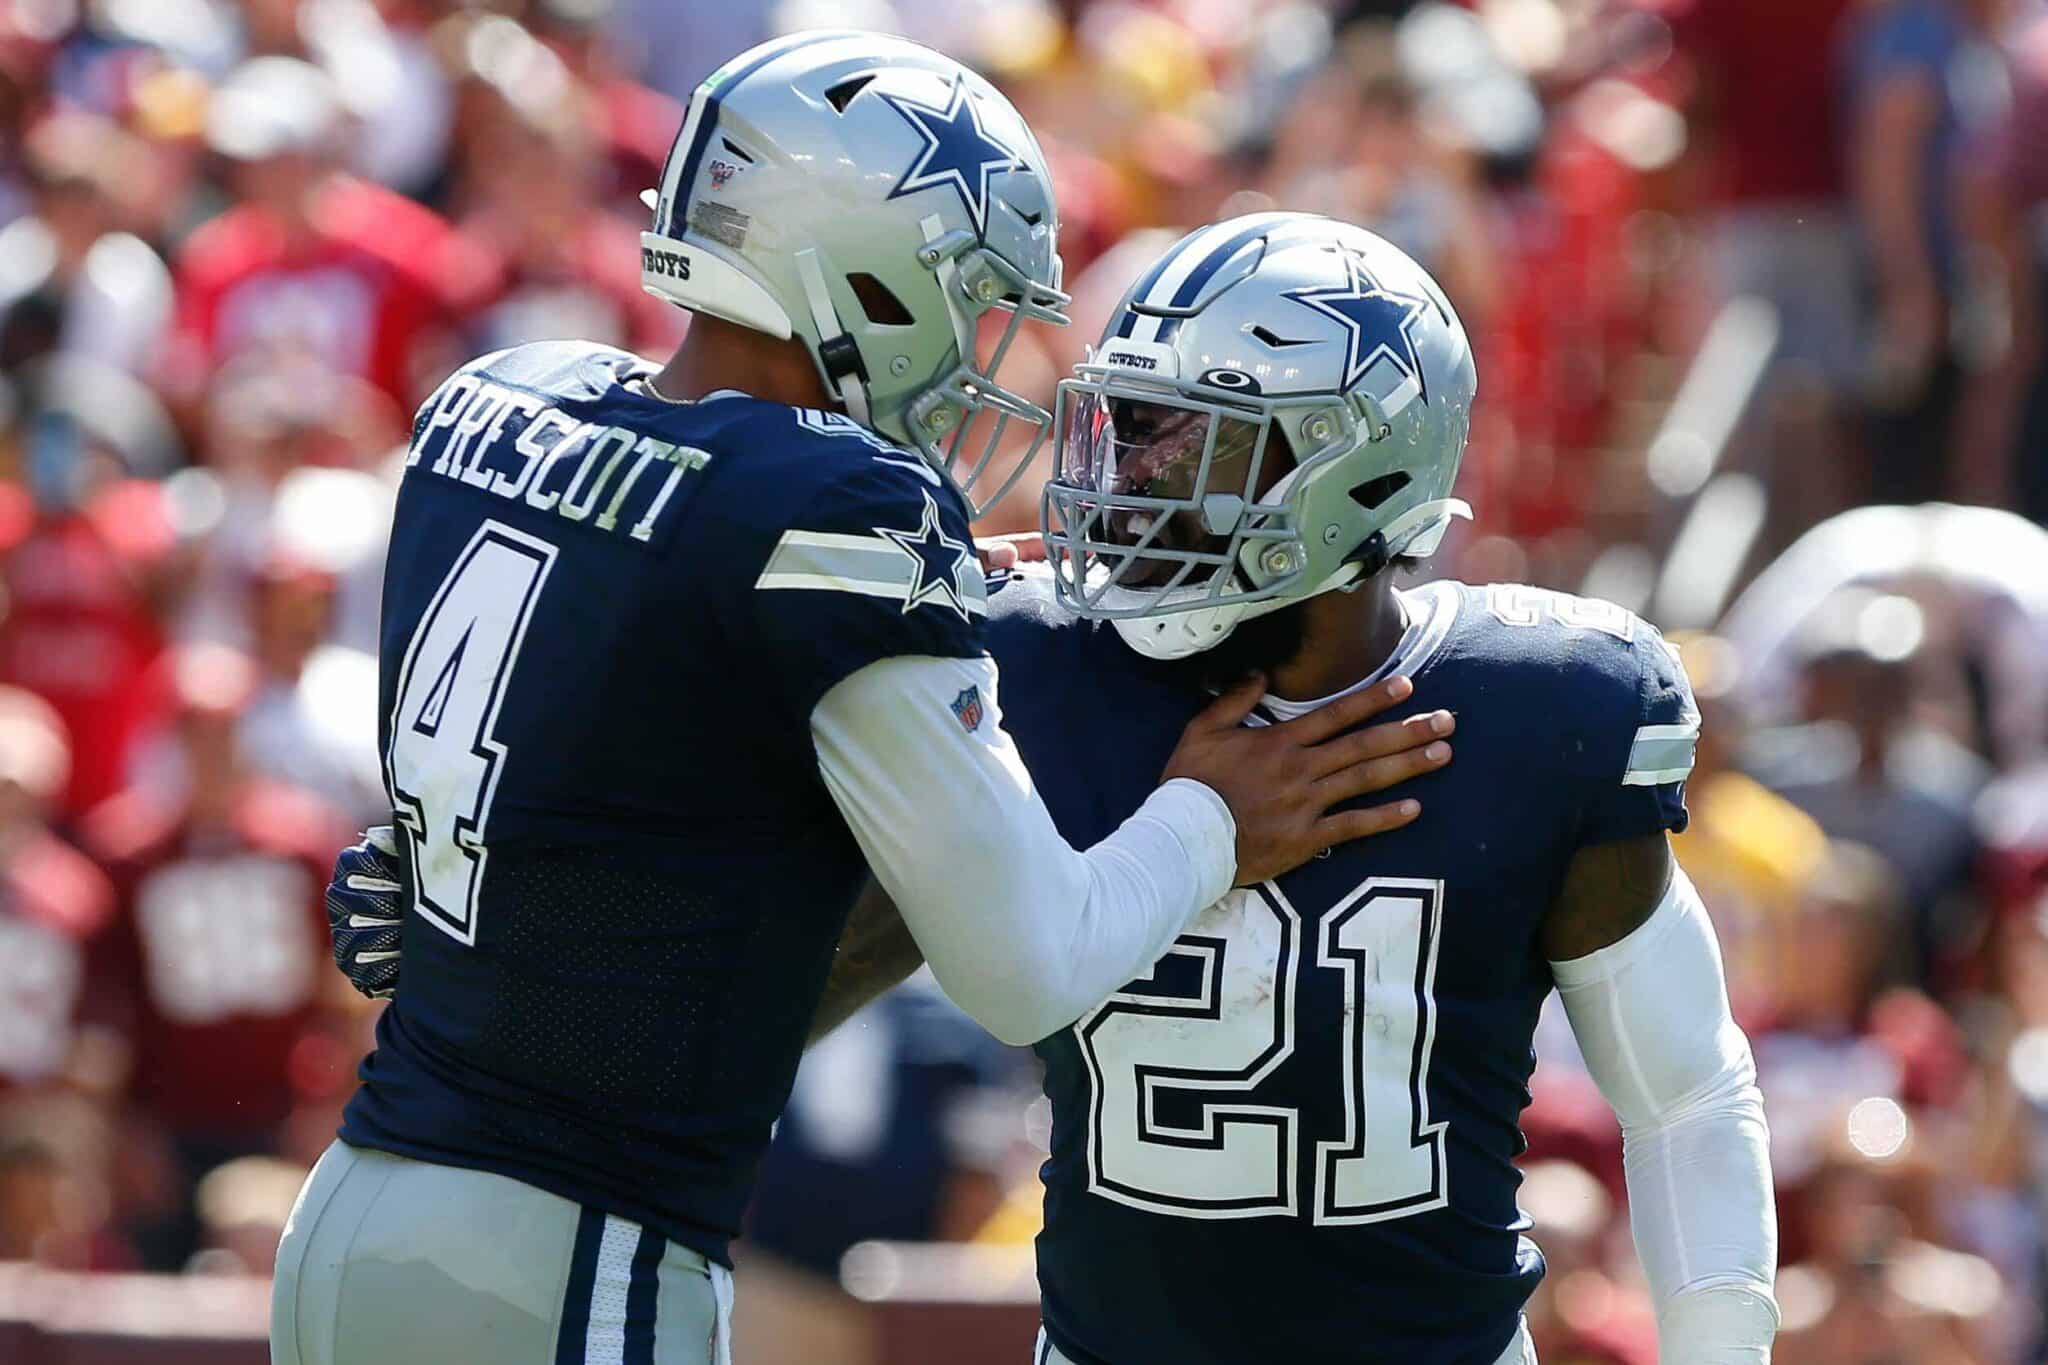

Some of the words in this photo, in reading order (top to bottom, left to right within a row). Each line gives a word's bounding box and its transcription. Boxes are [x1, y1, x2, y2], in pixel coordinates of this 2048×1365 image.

[406, 374, 712, 542] PRESCOTT
[1108, 351, 1158, 371] COWBOYS
[386, 518, 560, 947] 4
[1072, 876, 1450, 1226] 21
